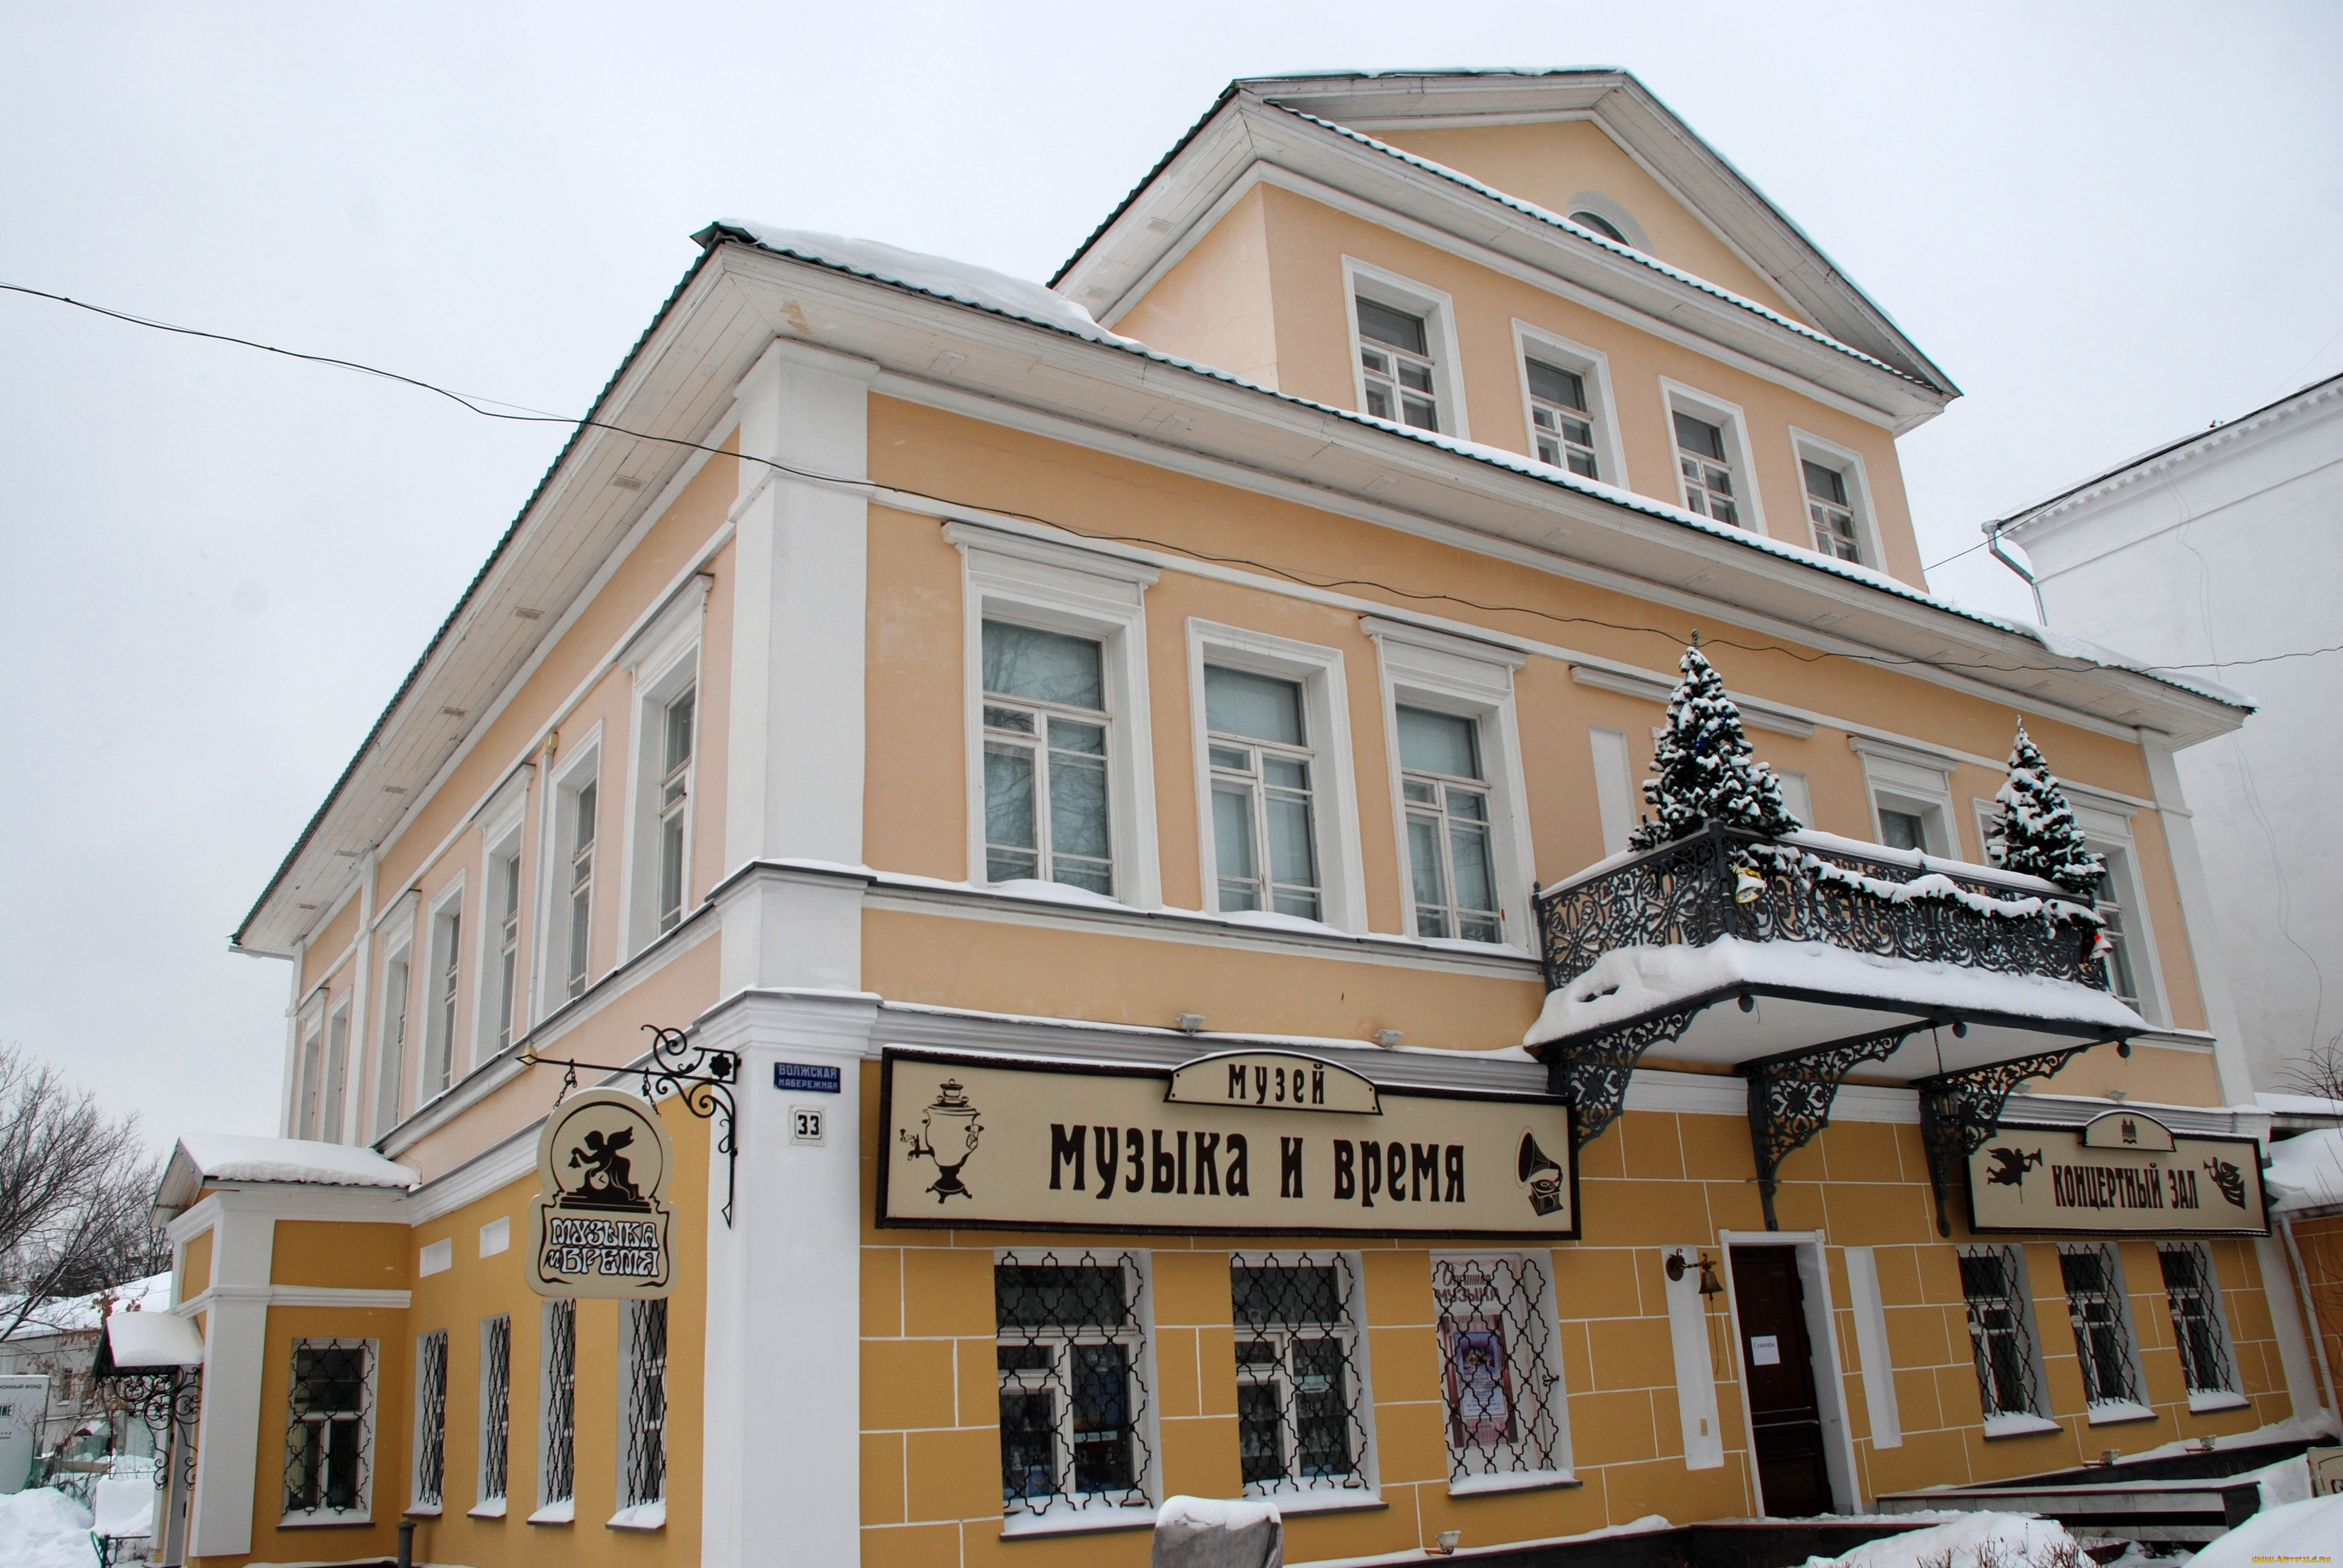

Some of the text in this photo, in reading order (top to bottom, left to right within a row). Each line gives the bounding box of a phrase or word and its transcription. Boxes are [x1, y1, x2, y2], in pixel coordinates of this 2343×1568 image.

[779, 1065, 837, 1079] ВОЛЖСКАЯ
[779, 1079, 838, 1089] НАБЕРЕЖНАЯ
[798, 1115, 819, 1135] 33
[2051, 1163, 2199, 1211] КОНЦЕРТНЫЙ ЗАЛ
[551, 1217, 660, 1249] МУЗЫКА
[560, 1246, 660, 1277] ВРЕМЯ
[1436, 1287, 1499, 1303] МУЗЫКА
